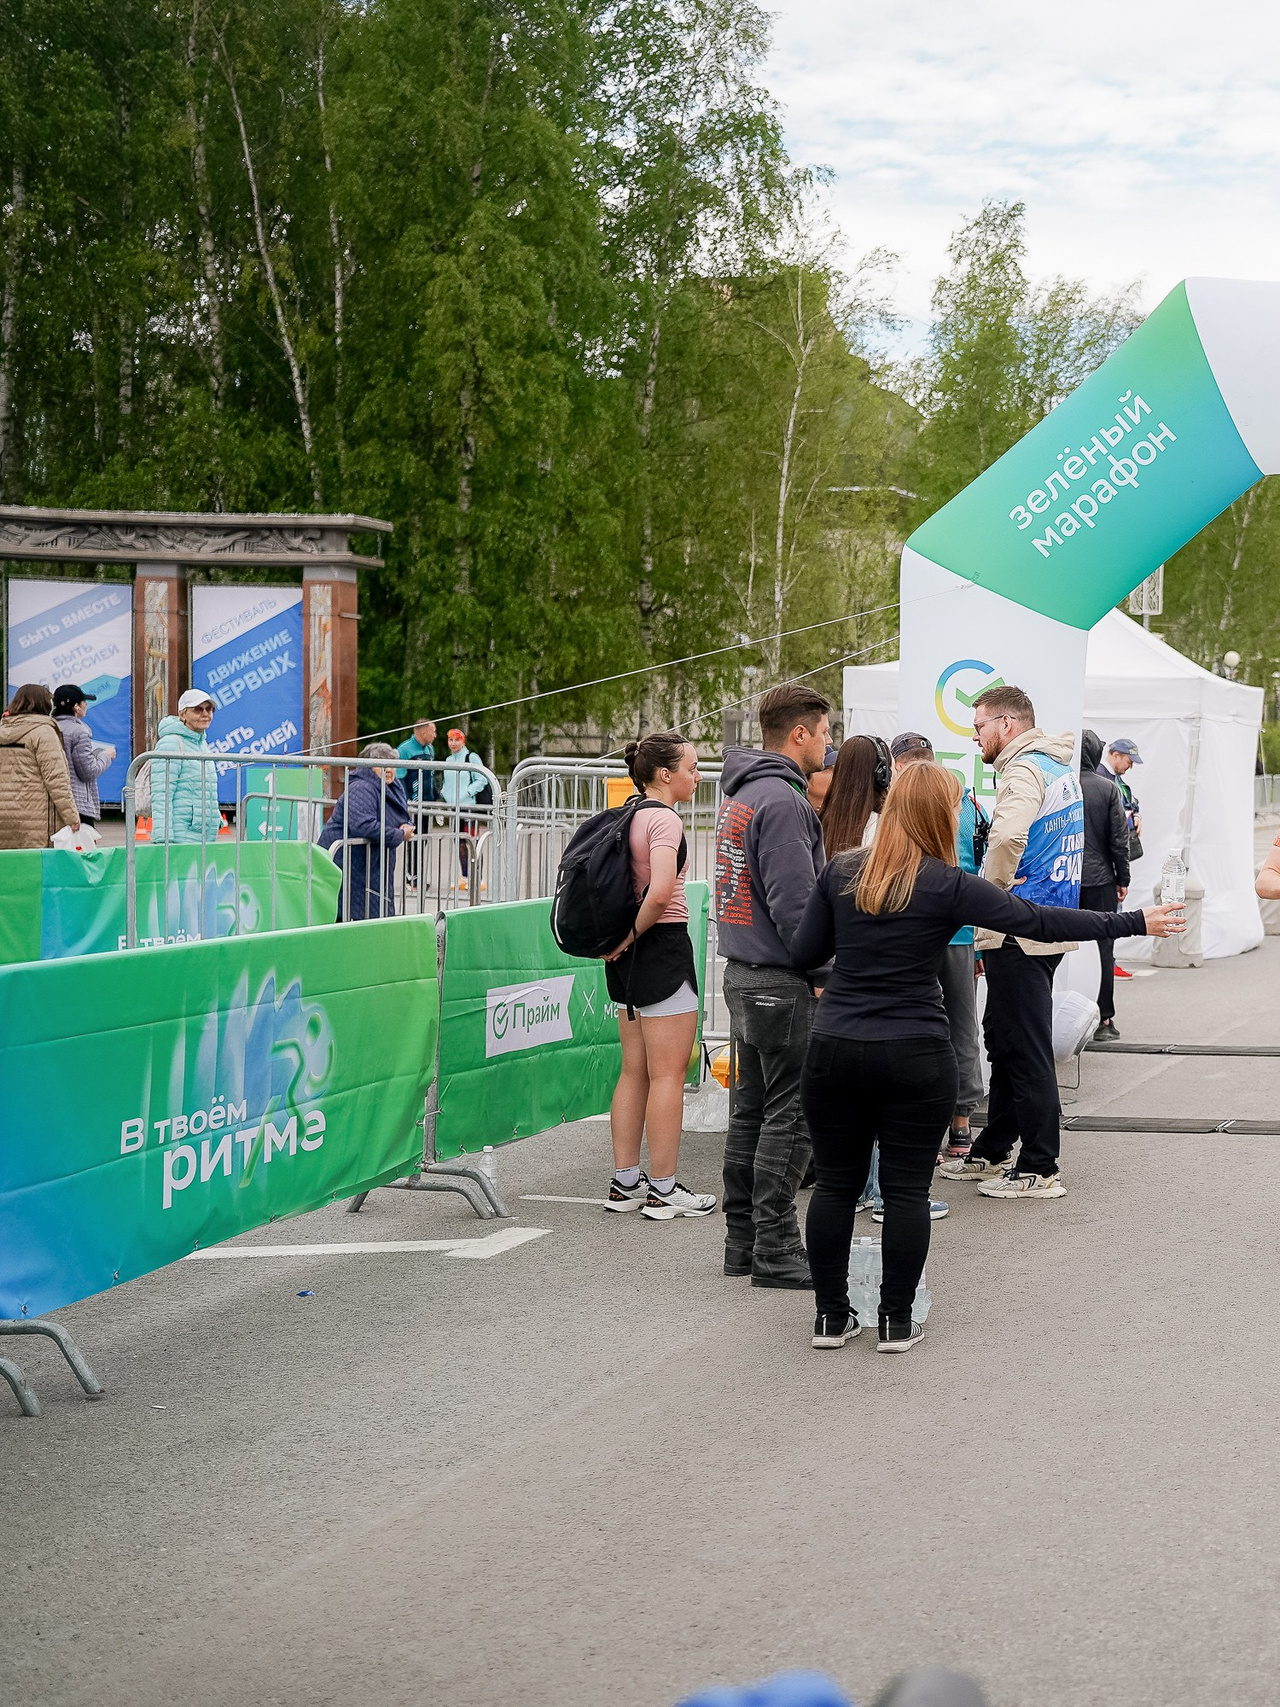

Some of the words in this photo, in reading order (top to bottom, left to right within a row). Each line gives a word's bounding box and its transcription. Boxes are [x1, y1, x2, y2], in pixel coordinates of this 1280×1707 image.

[1008, 388, 1153, 532] зелёный
[1030, 420, 1178, 559] марафон
[18, 623, 60, 649] БЫТЬ
[61, 592, 121, 629] ВМЕСТЕ
[201, 598, 277, 644] ФЕСТИВАЛЬ
[51, 642, 120, 684] РОССИЕЙ
[53, 643, 93, 668] БЫТЬ
[206, 628, 293, 688] ДВИЖЕНИЕ
[512, 995, 560, 1033] Прайм
[120, 1117, 144, 1154] В
[153, 1095, 247, 1144] твоём
[162, 1109, 327, 1210] ритме
